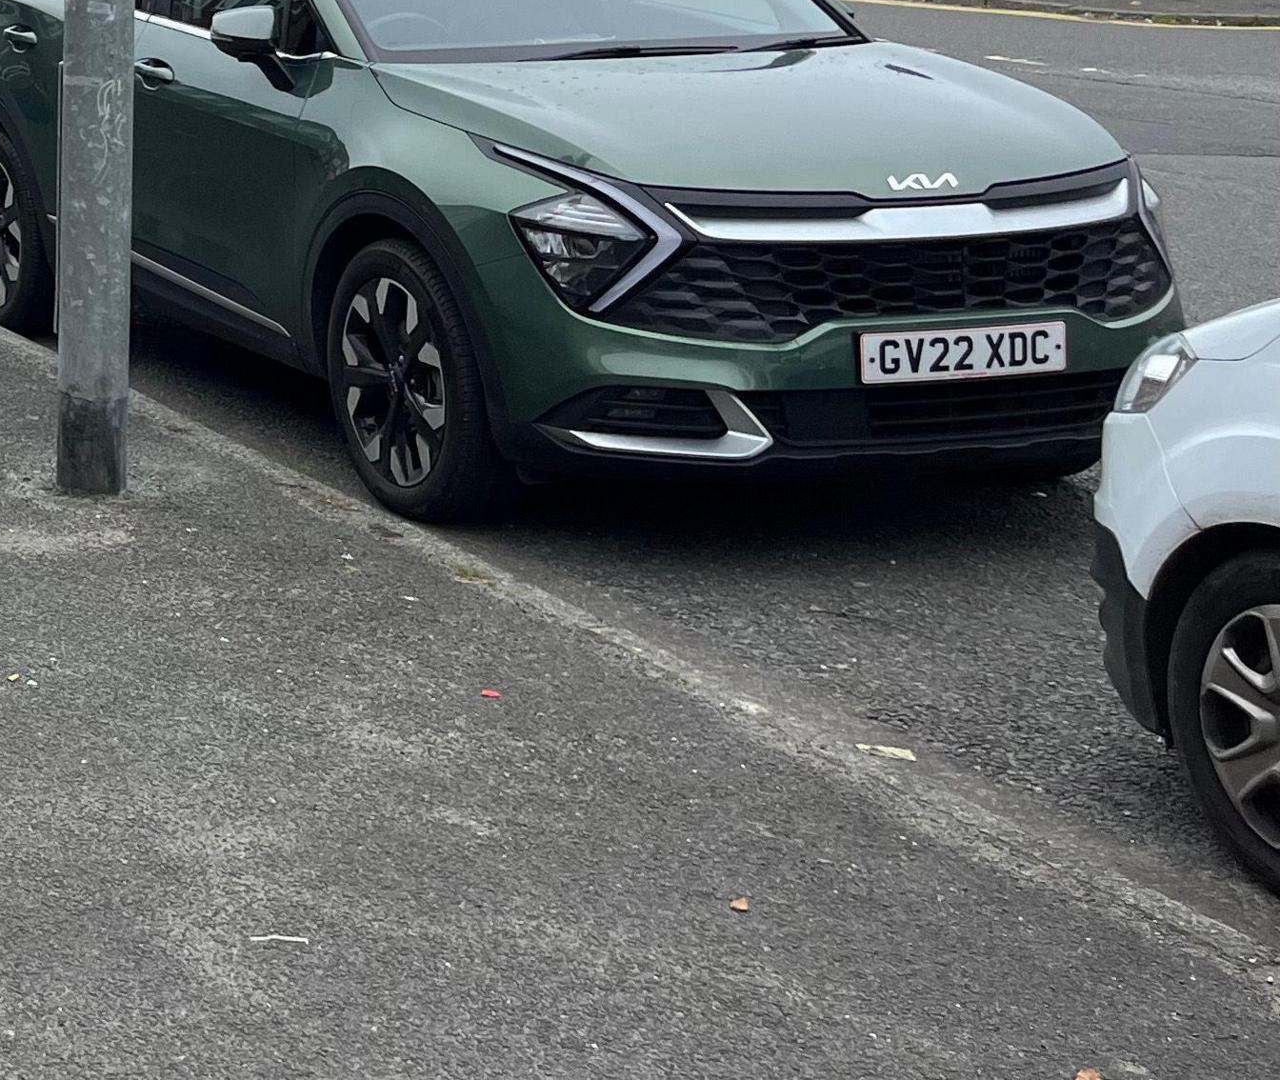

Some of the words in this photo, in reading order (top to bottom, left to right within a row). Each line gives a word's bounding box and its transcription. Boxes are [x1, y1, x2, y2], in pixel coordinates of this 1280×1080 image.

[886, 172, 959, 191] KIA
[878, 338, 974, 375] GV22
[985, 329, 1050, 369] XDC
